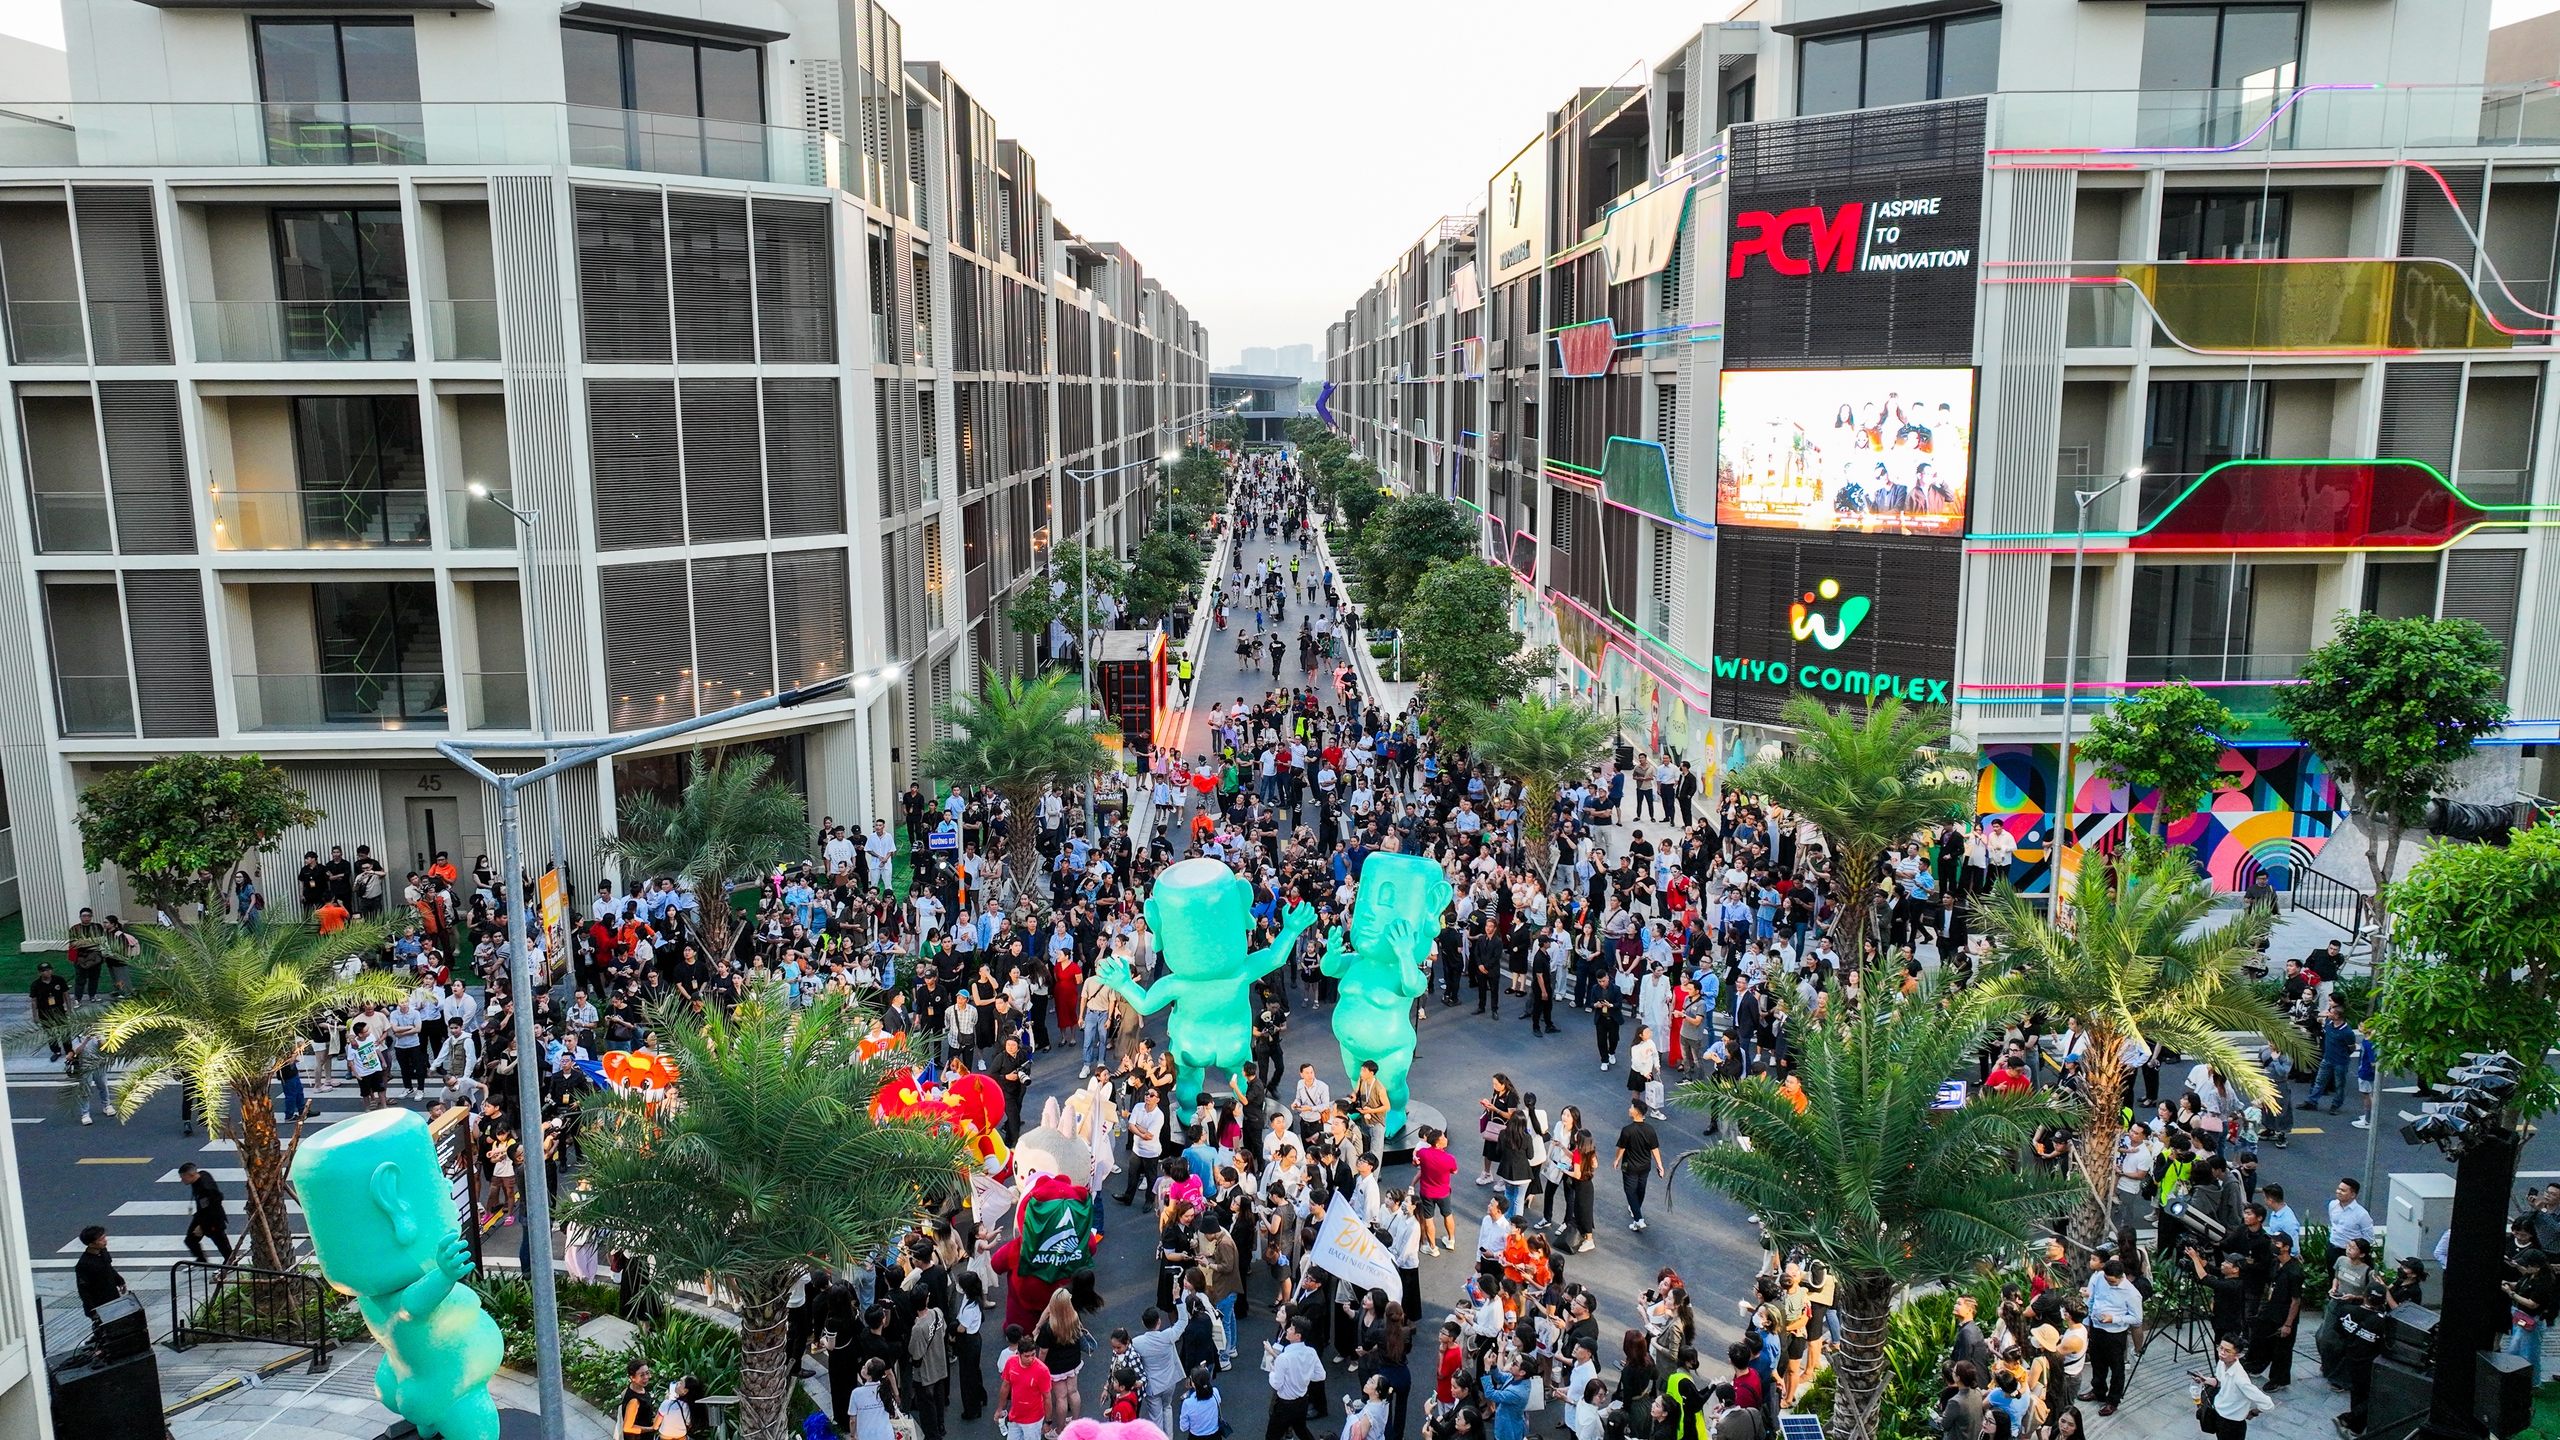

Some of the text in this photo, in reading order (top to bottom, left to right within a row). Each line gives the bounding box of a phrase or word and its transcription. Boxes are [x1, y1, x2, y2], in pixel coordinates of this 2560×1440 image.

[1878, 197, 1942, 218] ASPIRE
[1729, 202, 1863, 279] PCM
[1876, 227, 1900, 244] TO
[1868, 250, 1970, 271] INNOVATION
[1799, 665, 1949, 704] COMPLEX
[417, 774, 442, 792] 45
[1951, 1090, 1961, 1101] D7
